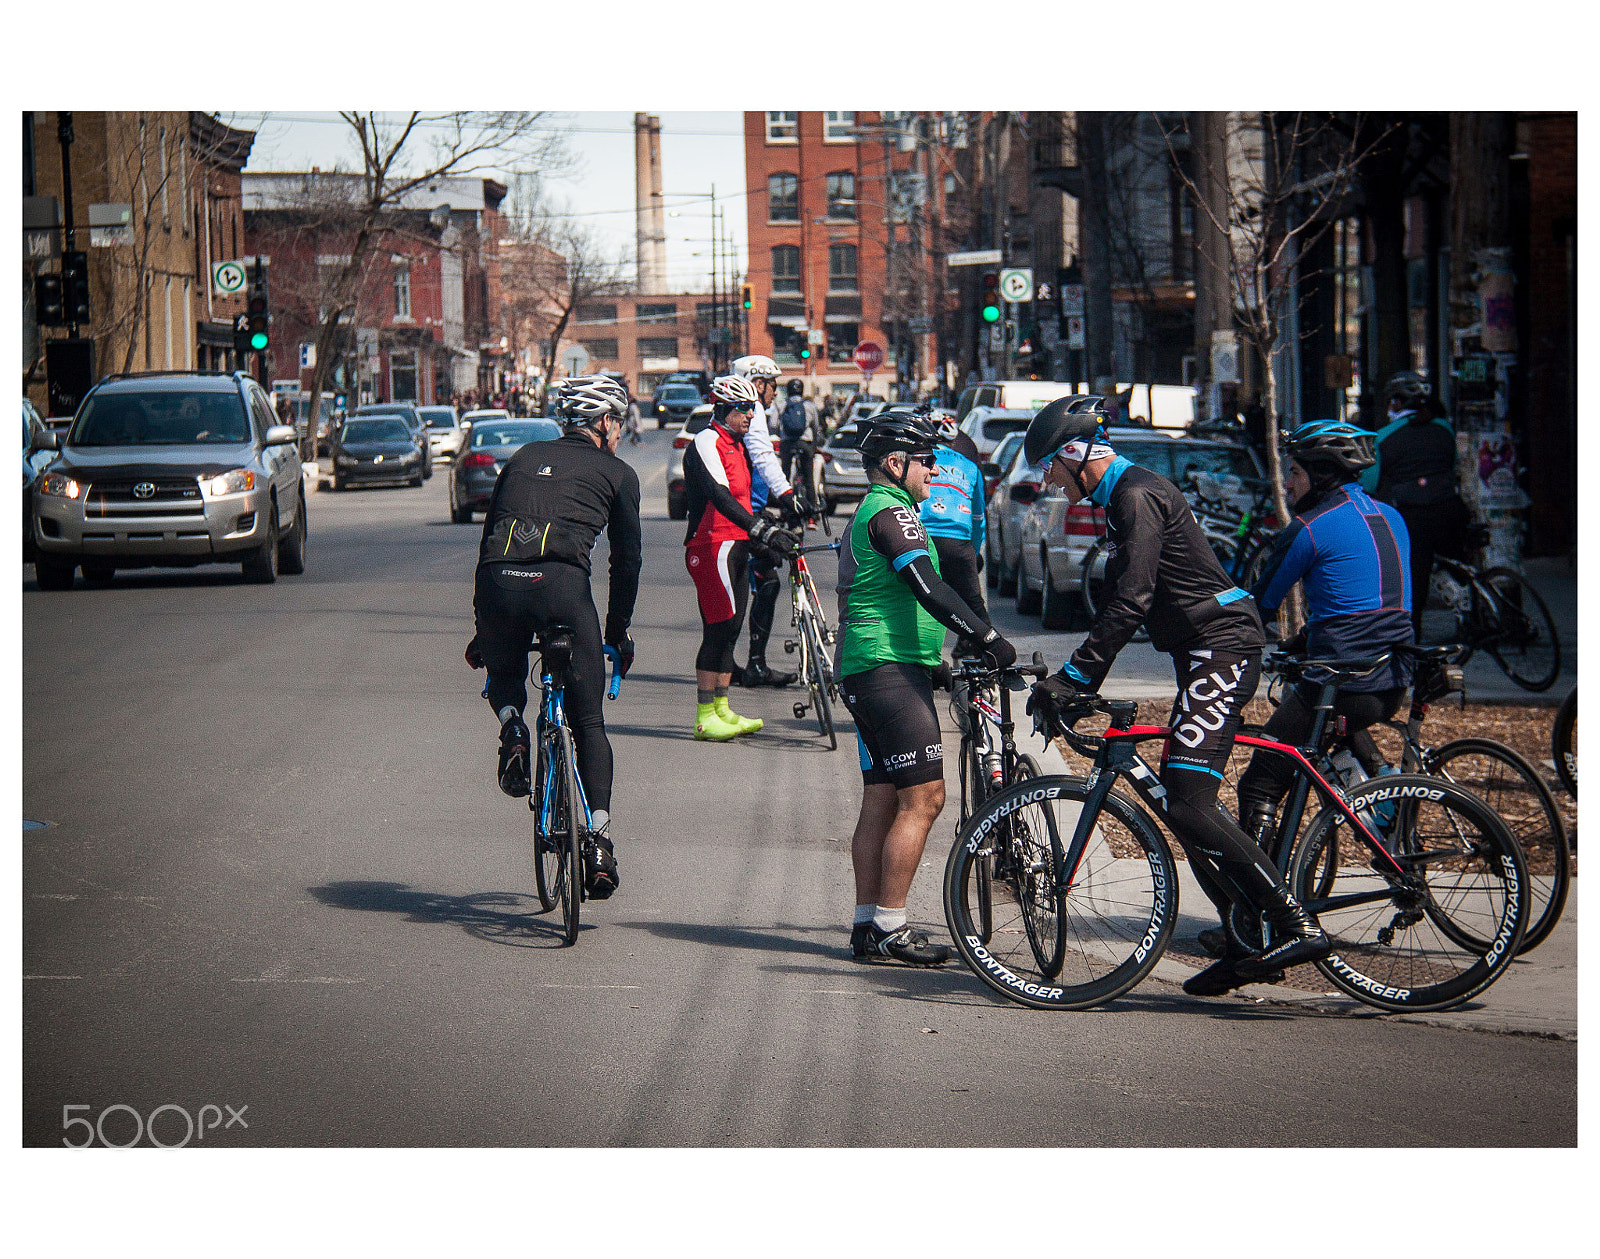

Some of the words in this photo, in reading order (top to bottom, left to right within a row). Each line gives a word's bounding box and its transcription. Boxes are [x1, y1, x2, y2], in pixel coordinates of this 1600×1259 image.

[965, 786, 1061, 854] BONTRAGER
[1134, 851, 1167, 965] BONTRAGER
[1484, 854, 1520, 969] BONTRAGER
[964, 934, 1064, 1000] BONTRAGER
[1326, 952, 1411, 1001] NTRAGER
